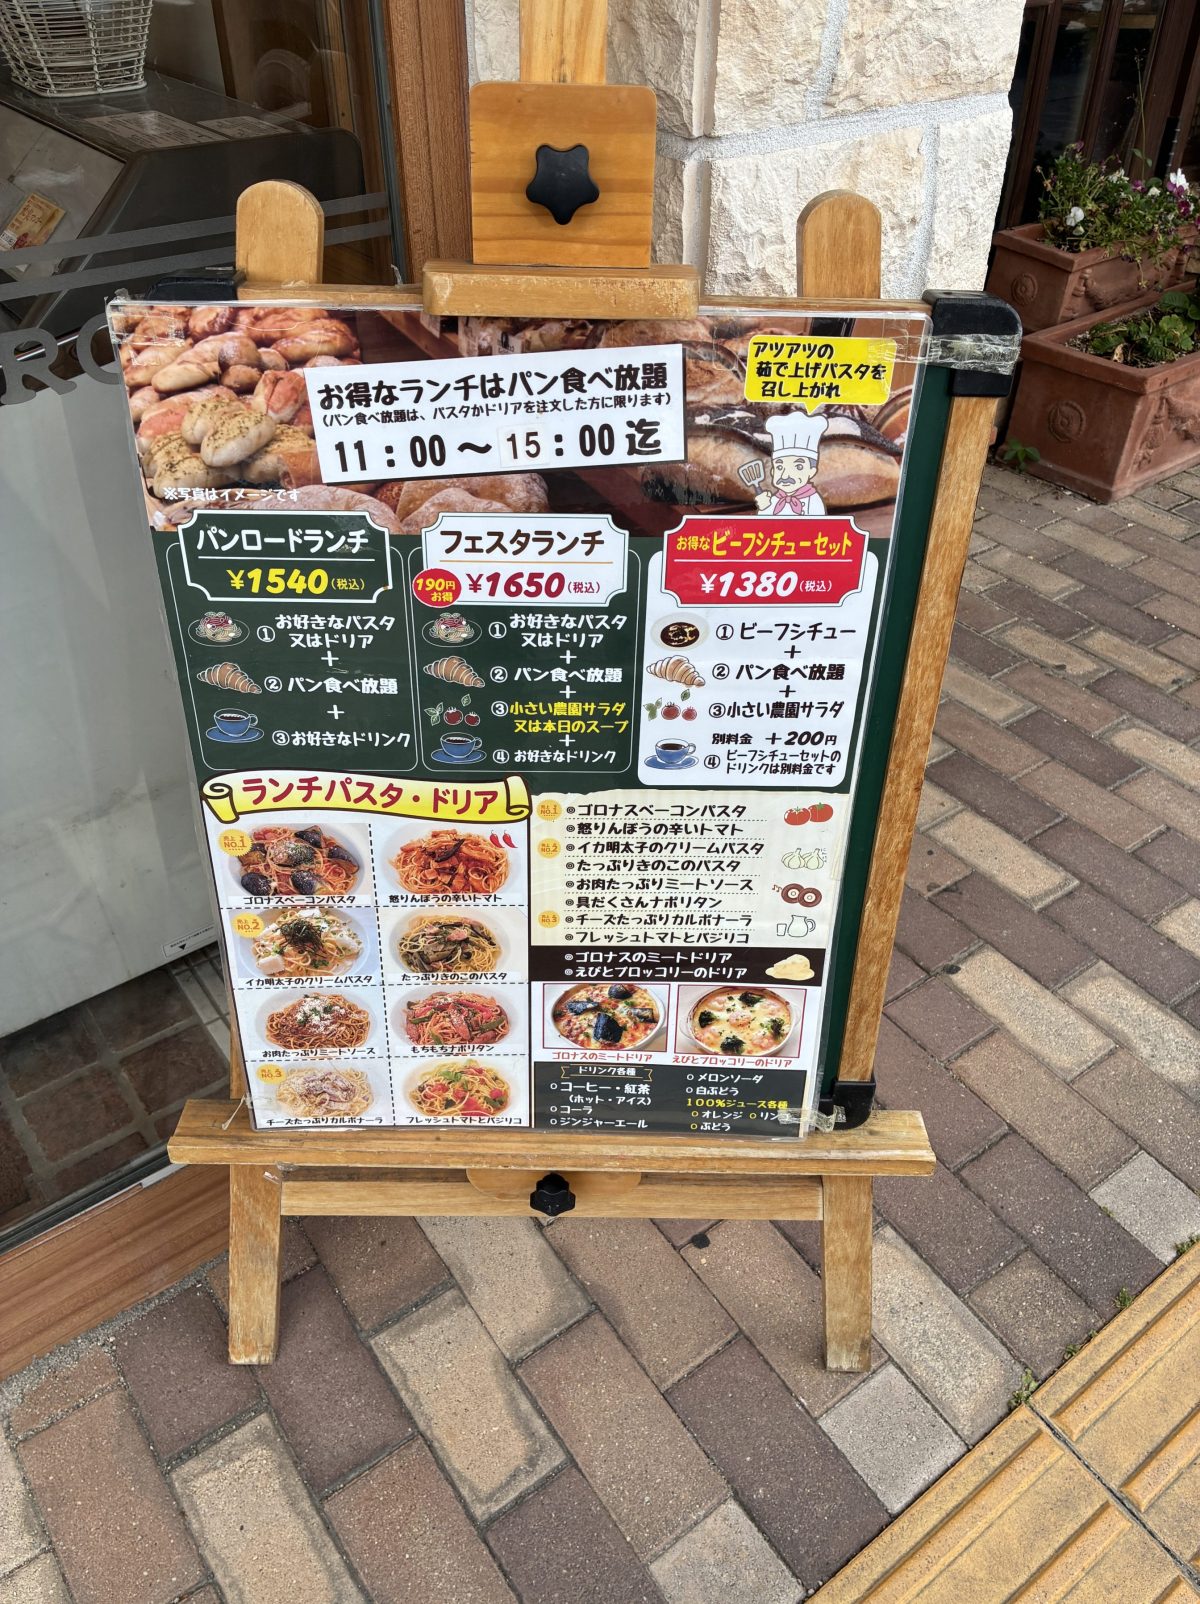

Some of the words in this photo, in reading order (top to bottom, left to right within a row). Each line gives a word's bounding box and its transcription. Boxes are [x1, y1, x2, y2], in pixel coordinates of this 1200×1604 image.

[753, 341, 834, 359] アツアツの
[756, 361, 887, 380] 茹で上げパスタを
[317, 363, 668, 410] お得なランチはパン食べ放題
[761, 381, 841, 399] 召し上がれ
[323, 392, 671, 427] （パン食べ放題は、パスタかドリアを注文した方に限ります）
[164, 487, 300, 501] ※写真はイメージです
[196, 526, 369, 554] パンロードランチ
[440, 529, 605, 557] フェスタランチ
[416, 578, 456, 591] 190円
[431, 592, 453, 603] お得
[275, 614, 395, 631] お好きなパスタ
[509, 613, 628, 630] お好きなパスタ
[740, 622, 856, 641] ビーフシチュー
[288, 633, 374, 649] 又はドリア
[521, 632, 604, 648] 又はドリア
[514, 667, 623, 683] パン食べ放題
[735, 663, 845, 681] パン食べ放題
[287, 677, 399, 695] パン食べ放題
[513, 719, 629, 734] 又は本日のスープ
[711, 733, 753, 745] 別料金
[513, 749, 617, 764] お好きなドリンク
[726, 749, 842, 763] ビーフシチューセットの
[726, 763, 836, 776] ドリンクは別料金です
[242, 775, 499, 815] ランチパスタ・ドリア
[243, 895, 356, 905] ゴロナスベーコンパスタ
[388, 893, 503, 904] 怒りんぼうの辛いトマト
[245, 975, 373, 986] イカ明太子のクリームパスタ
[401, 972, 508, 981] たっぷりきのこのパスタ
[262, 1047, 376, 1058] お肉たっぷりミートソース
[410, 1044, 495, 1053] もちもちナポリタン
[552, 1051, 653, 1063] ゴロナスのミートドリア
[672, 1055, 793, 1068] えびとブロッコリーのドリア
[579, 1065, 637, 1076] ドリンク各種
[266, 1116, 383, 1126] チーズたっぷりカルボナーラ
